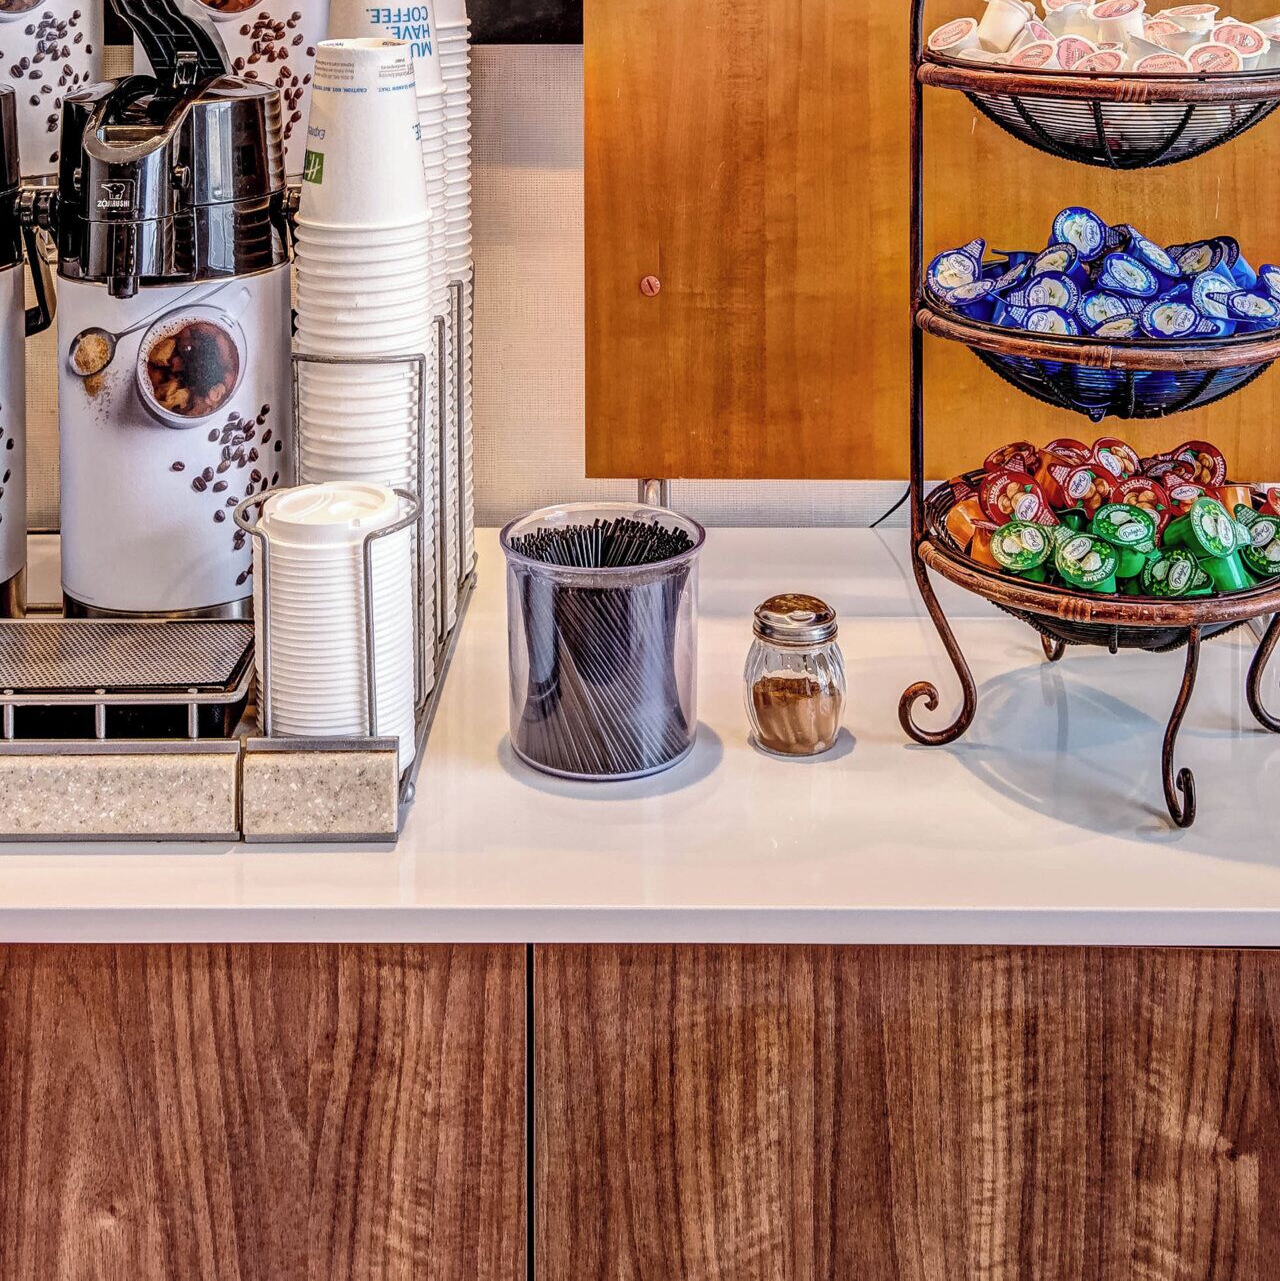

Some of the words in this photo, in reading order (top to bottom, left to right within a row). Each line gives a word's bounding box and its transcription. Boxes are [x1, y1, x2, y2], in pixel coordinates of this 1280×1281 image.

[366, 6, 428, 24] COFFEE.
[386, 23, 430, 40] HAVE.
[410, 41, 432, 58] MU
[97, 198, 130, 209] ZOJIRUSHI
[988, 475, 1010, 505] HAZELNUT
[1119, 478, 1153, 493] HAZELNUT
